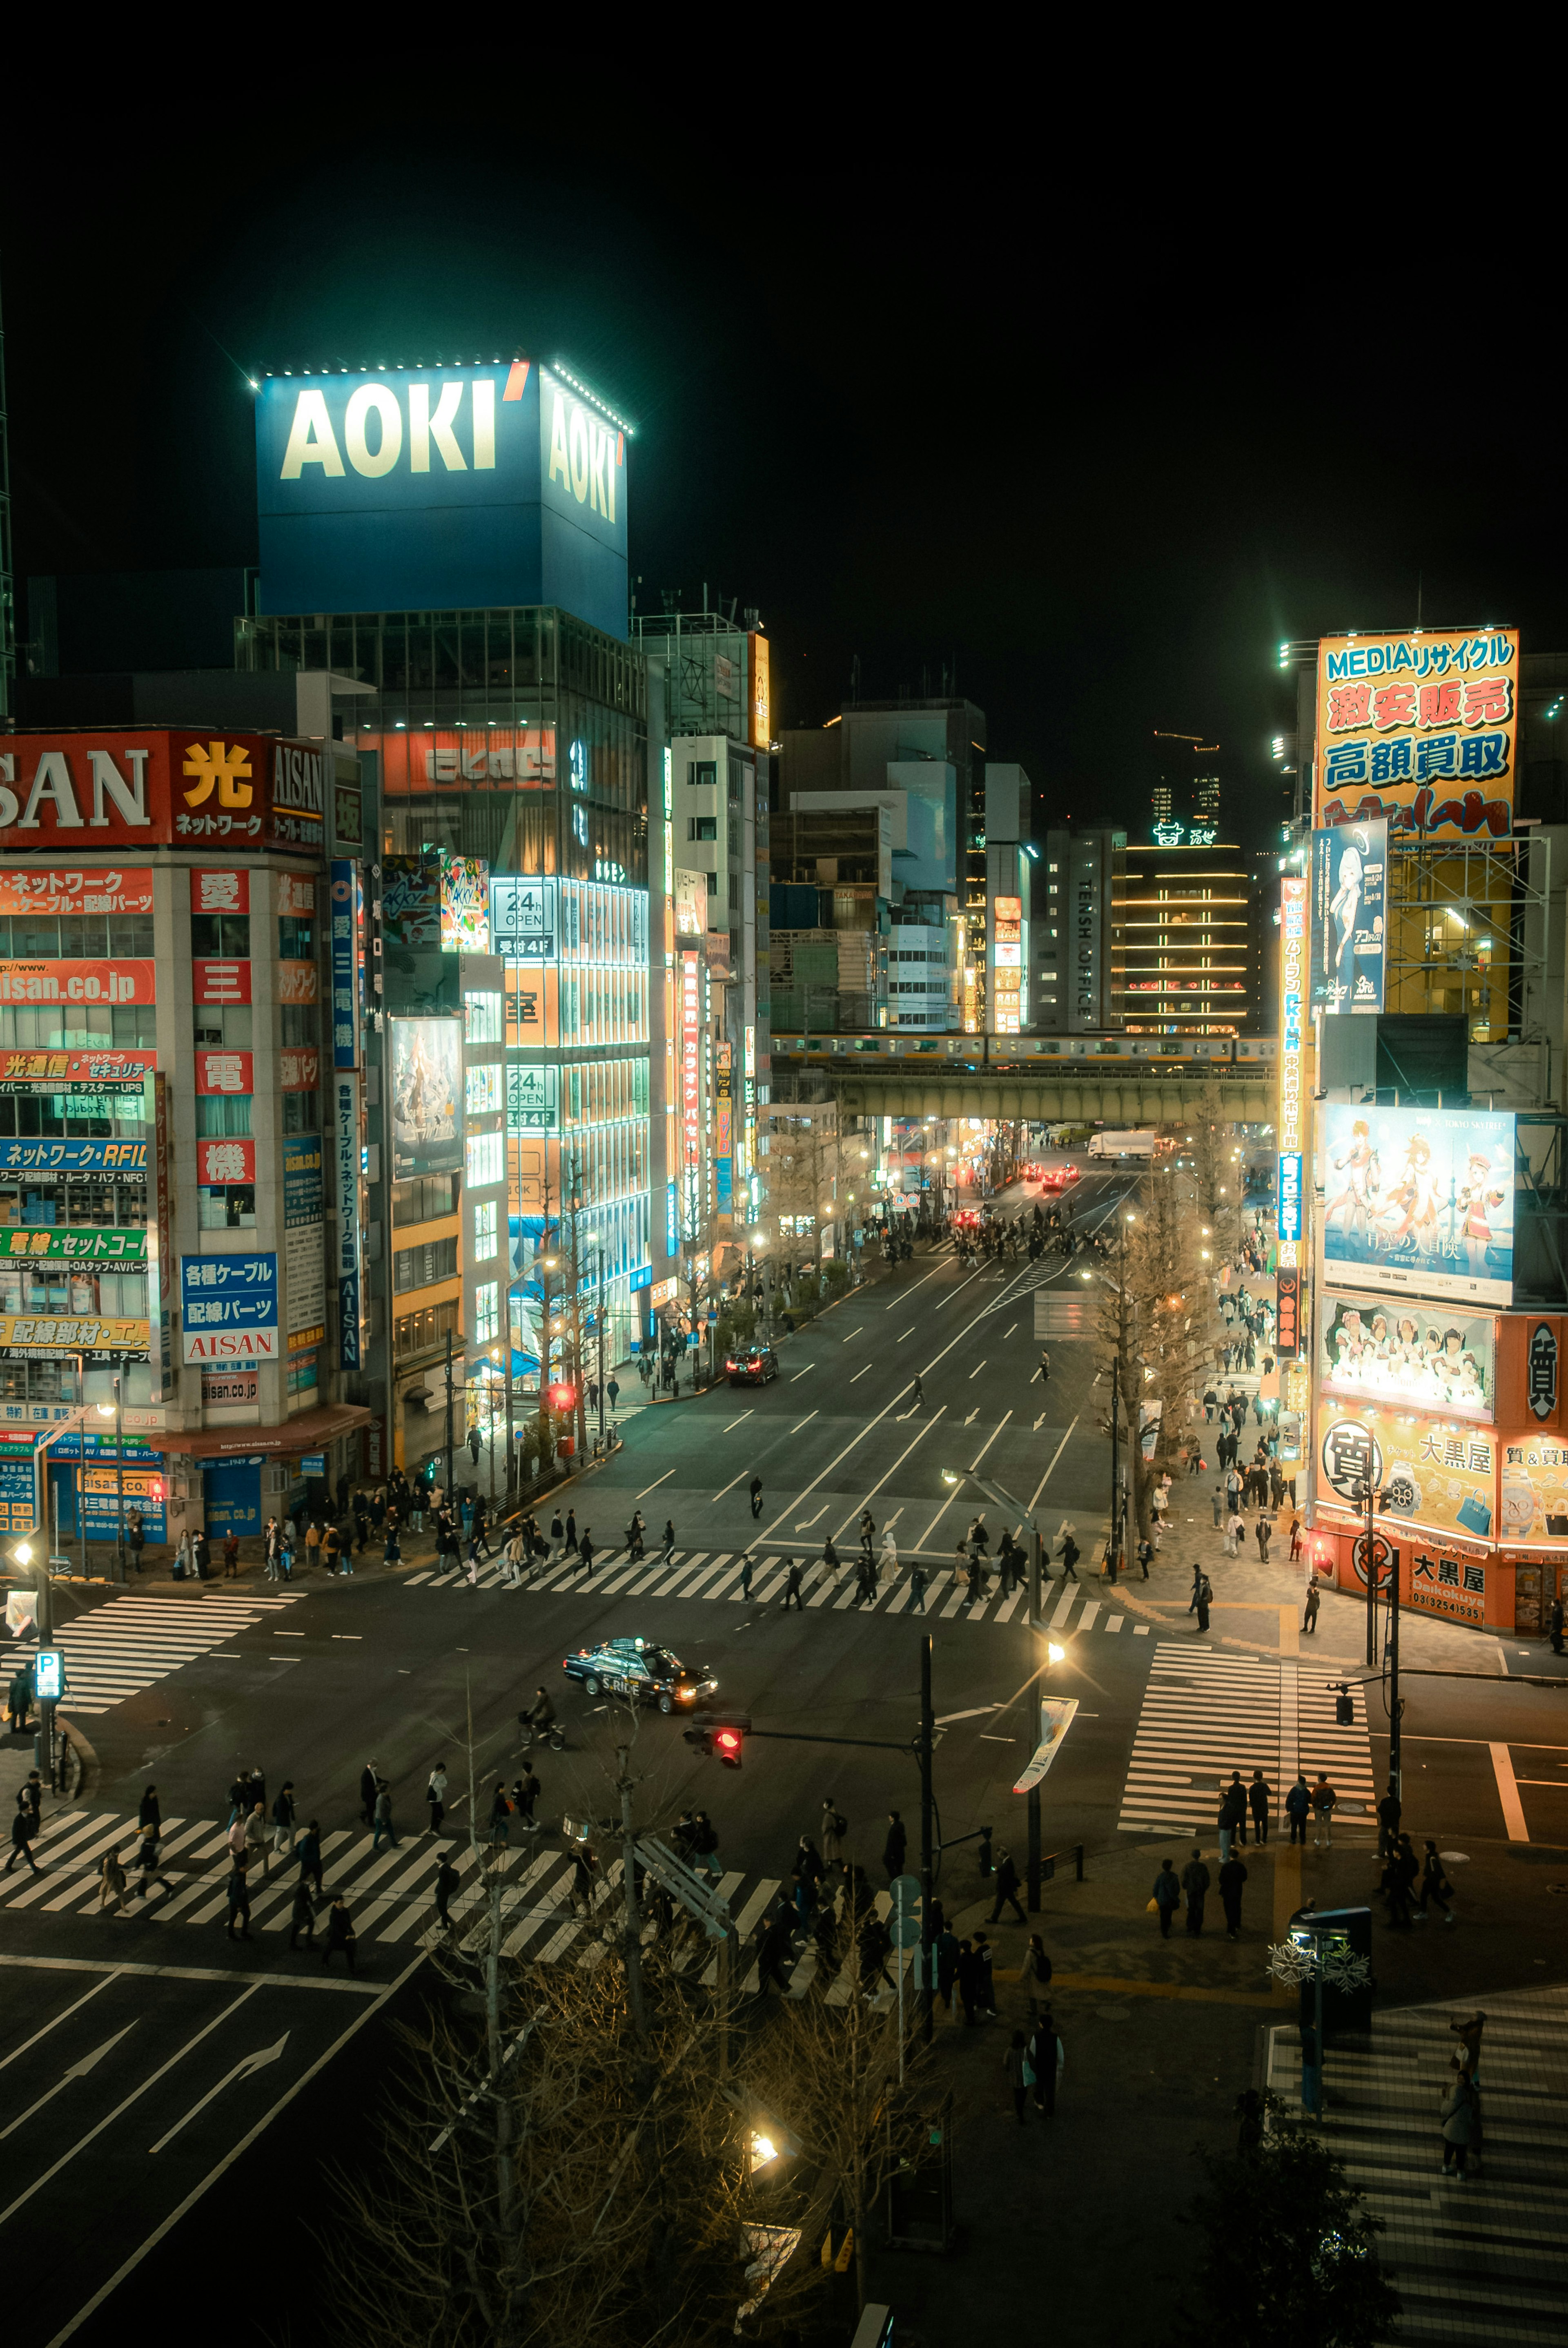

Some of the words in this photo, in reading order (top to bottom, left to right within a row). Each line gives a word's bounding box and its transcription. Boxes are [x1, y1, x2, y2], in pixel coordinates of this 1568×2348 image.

[280, 379, 495, 479] AOKI
[549, 392, 615, 524] AOKI
[1327, 634, 1512, 681] MEDIAリサイクル
[1327, 677, 1510, 730] 激安販売
[1324, 731, 1507, 788] 高額買取
[183, 742, 253, 808] 光
[273, 745, 324, 811] AISAN
[176, 815, 261, 836] ネットワーク
[0, 872, 122, 894] ・ネットワーク
[201, 873, 239, 909] 愛
[507, 892, 541, 911] 24h
[506, 915, 541, 925] OPEN
[499, 940, 548, 953] 受付4F
[0, 972, 135, 1000] isan.co.jp
[204, 966, 241, 998] 三
[278, 968, 317, 998] ネットワーク
[334, 915, 352, 1047] 愛三電機
[996, 994, 1018, 1006] 848
[81, 1054, 125, 1063] ネットワーク
[89, 1063, 154, 1078] セキュリティ
[205, 1056, 243, 1090] 電
[685, 1042, 697, 1100] カラオケ
[510, 1072, 543, 1090] 24h
[509, 1094, 543, 1104] OPEN
[719, 1112, 730, 1154] DVD
[206, 1144, 245, 1181] 機
[186, 1262, 272, 1286] 各種ケーブル
[188, 1300, 271, 1324] 配線パーツ
[342, 1281, 355, 1361] AISAN
[189, 1333, 272, 1358] AISAN
[1528, 1336, 1557, 1411] 質
[202, 1380, 256, 1399] aisan.co.jp
[6, 1406, 22, 1418] 特約
[33, 1407, 48, 1419] 在庫
[1420, 1434, 1492, 1474] 大黒屋
[1412, 1554, 1484, 1594] 大黒屋
[1413, 1579, 1484, 1607] Daikokuya
[41, 1655, 54, 1672] P
